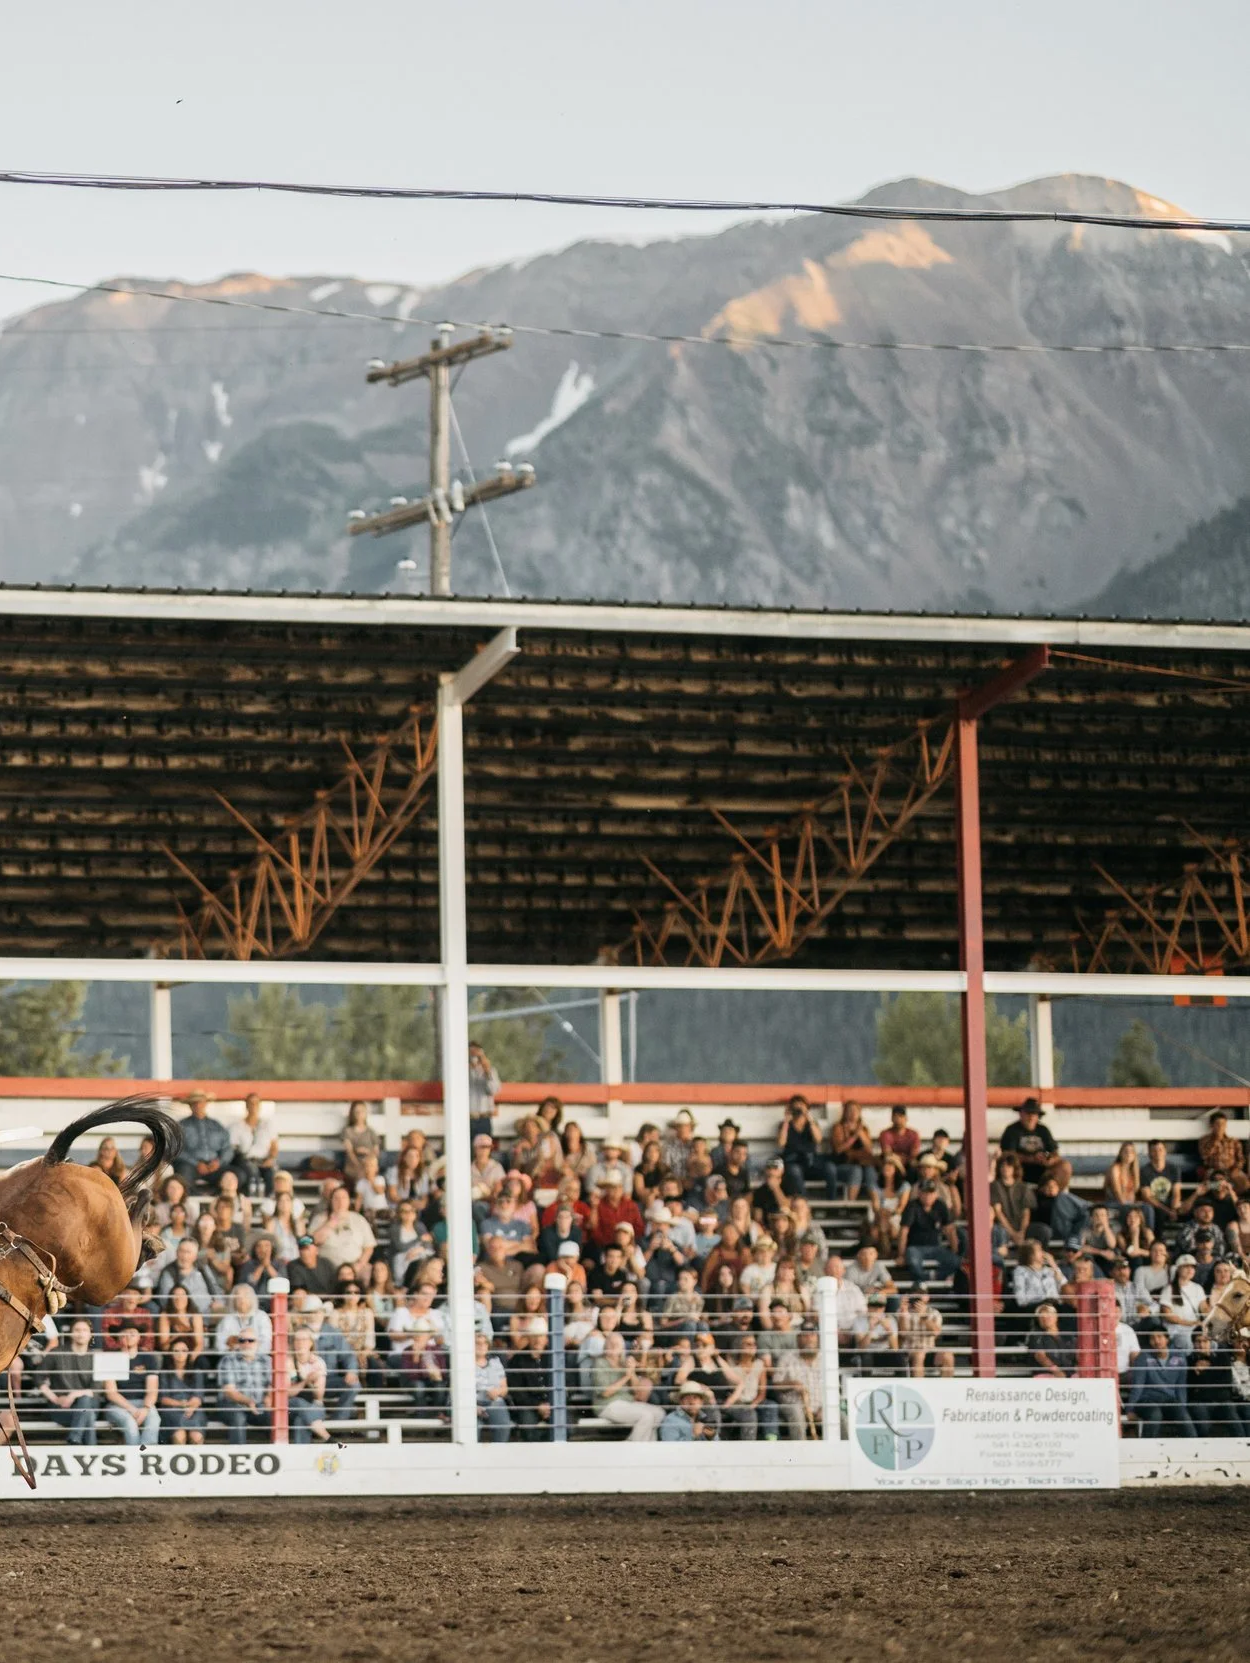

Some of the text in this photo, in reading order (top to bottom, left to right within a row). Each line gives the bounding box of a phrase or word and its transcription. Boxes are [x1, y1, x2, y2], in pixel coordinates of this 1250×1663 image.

[965, 1387, 1089, 1405] Renaissance Design,
[942, 1408, 1114, 1425] Fabrication & Powdercoating
[1012, 1432, 1050, 1440] Oregon
[1052, 1432, 1080, 1440] Shop
[140, 1453, 281, 1476] RODEO
[875, 1477, 905, 1486] Your
[911, 1477, 940, 1486] One
[946, 1477, 978, 1487] Stop
[984, 1476, 1015, 1487] High
[1025, 1475, 1057, 1486] Tech
[1063, 1476, 1099, 1487] Shop
